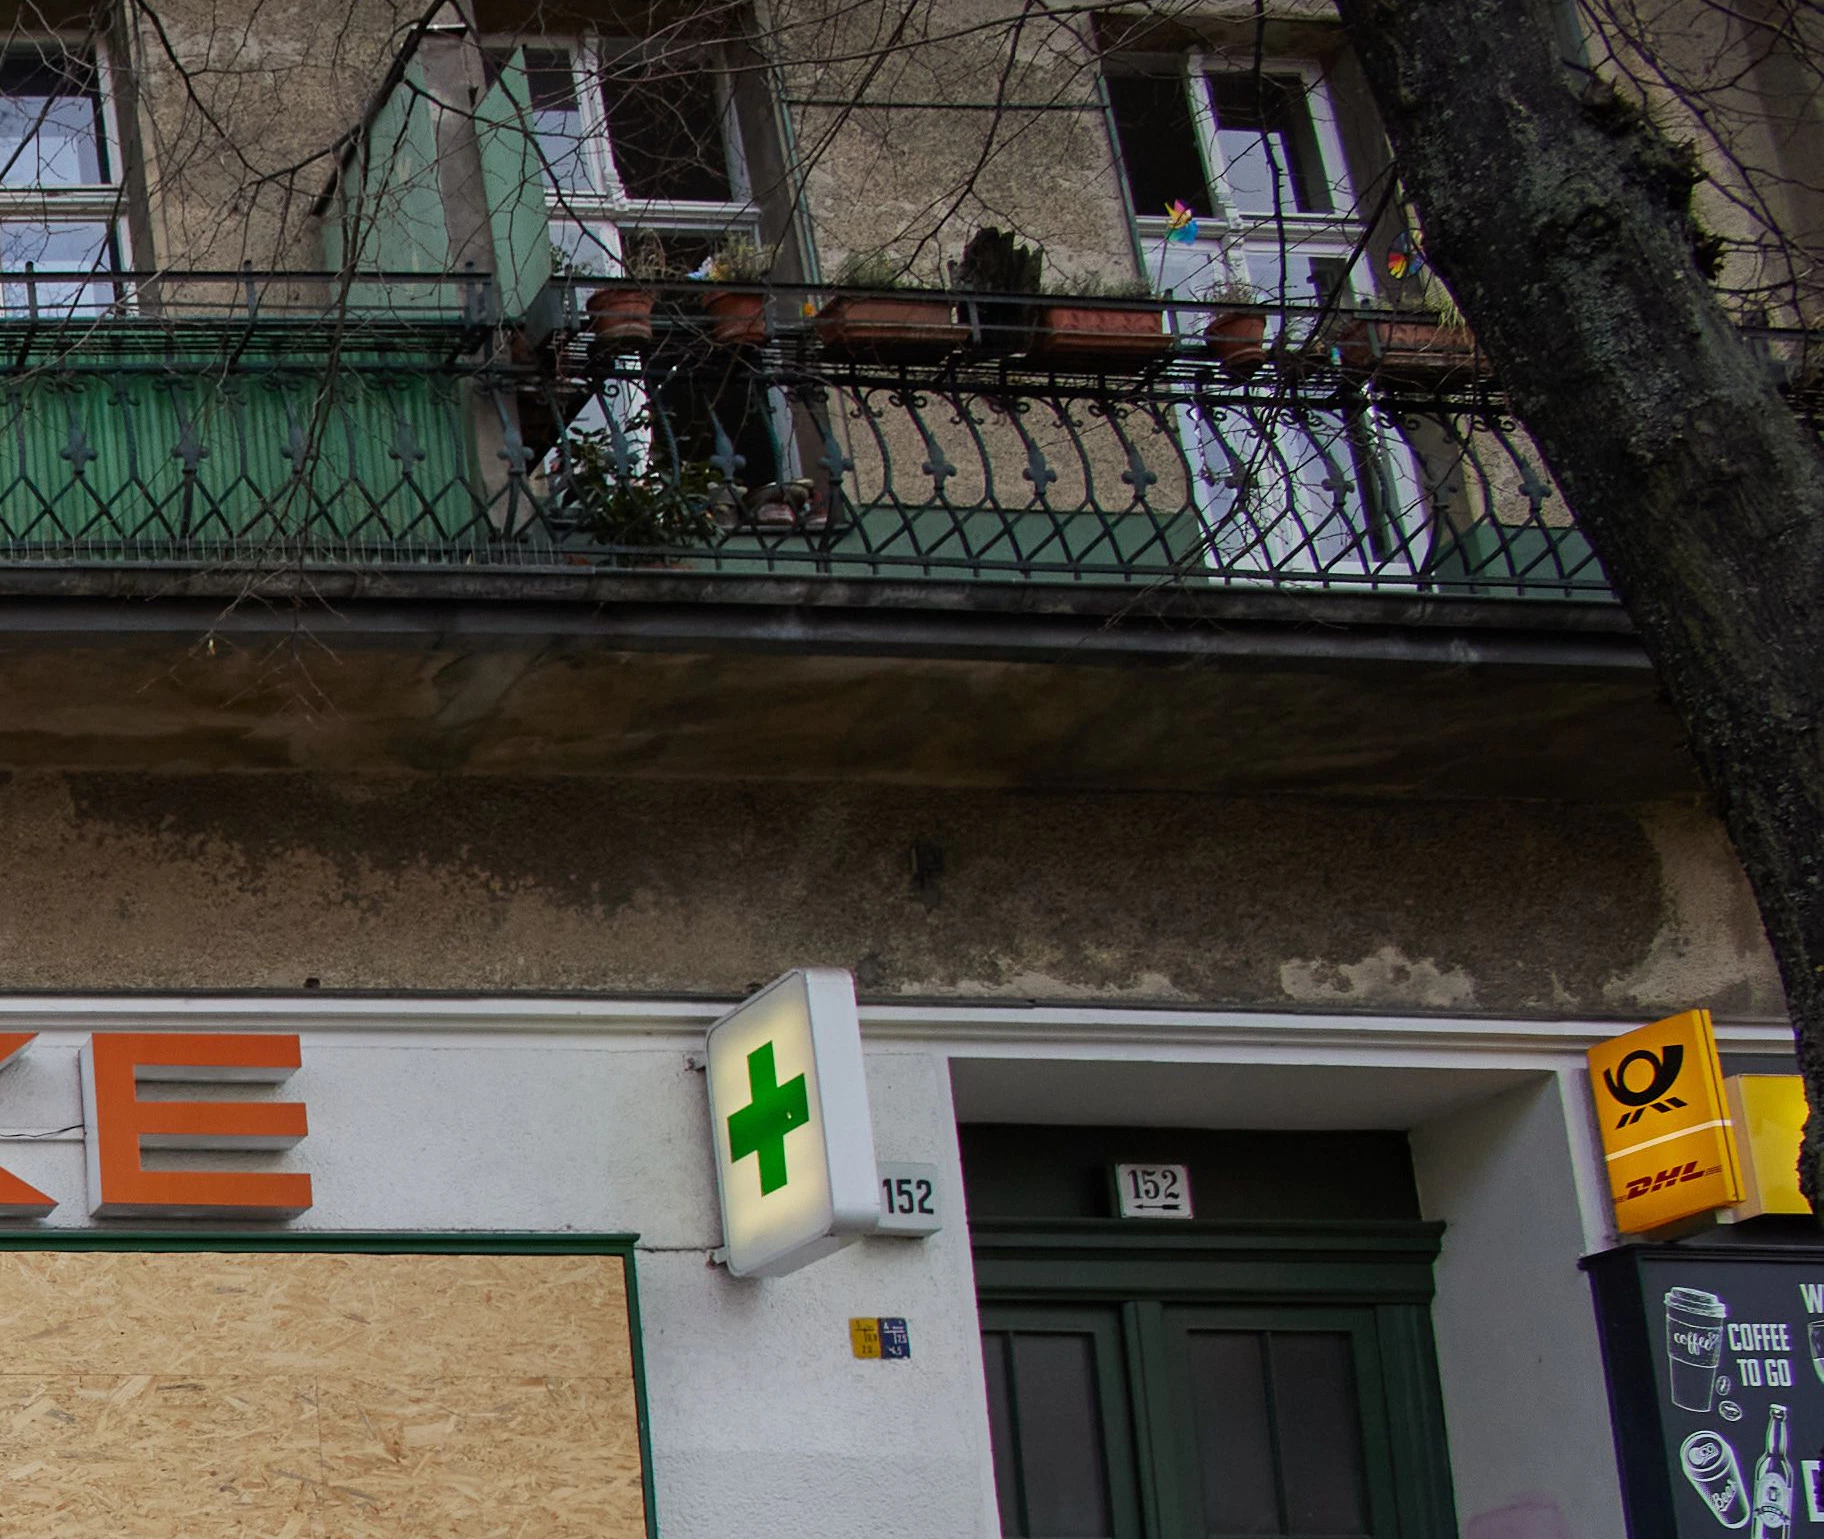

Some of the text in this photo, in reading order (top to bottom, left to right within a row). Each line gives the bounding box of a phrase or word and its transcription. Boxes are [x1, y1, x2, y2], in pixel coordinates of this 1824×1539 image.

[1128, 1169, 1181, 1200] 152
[1625, 1161, 1705, 1200] DHL
[883, 1178, 935, 1215] 152
[1727, 1323, 1791, 1351] COFFEE
[1736, 1358, 1793, 1387] TO GO
